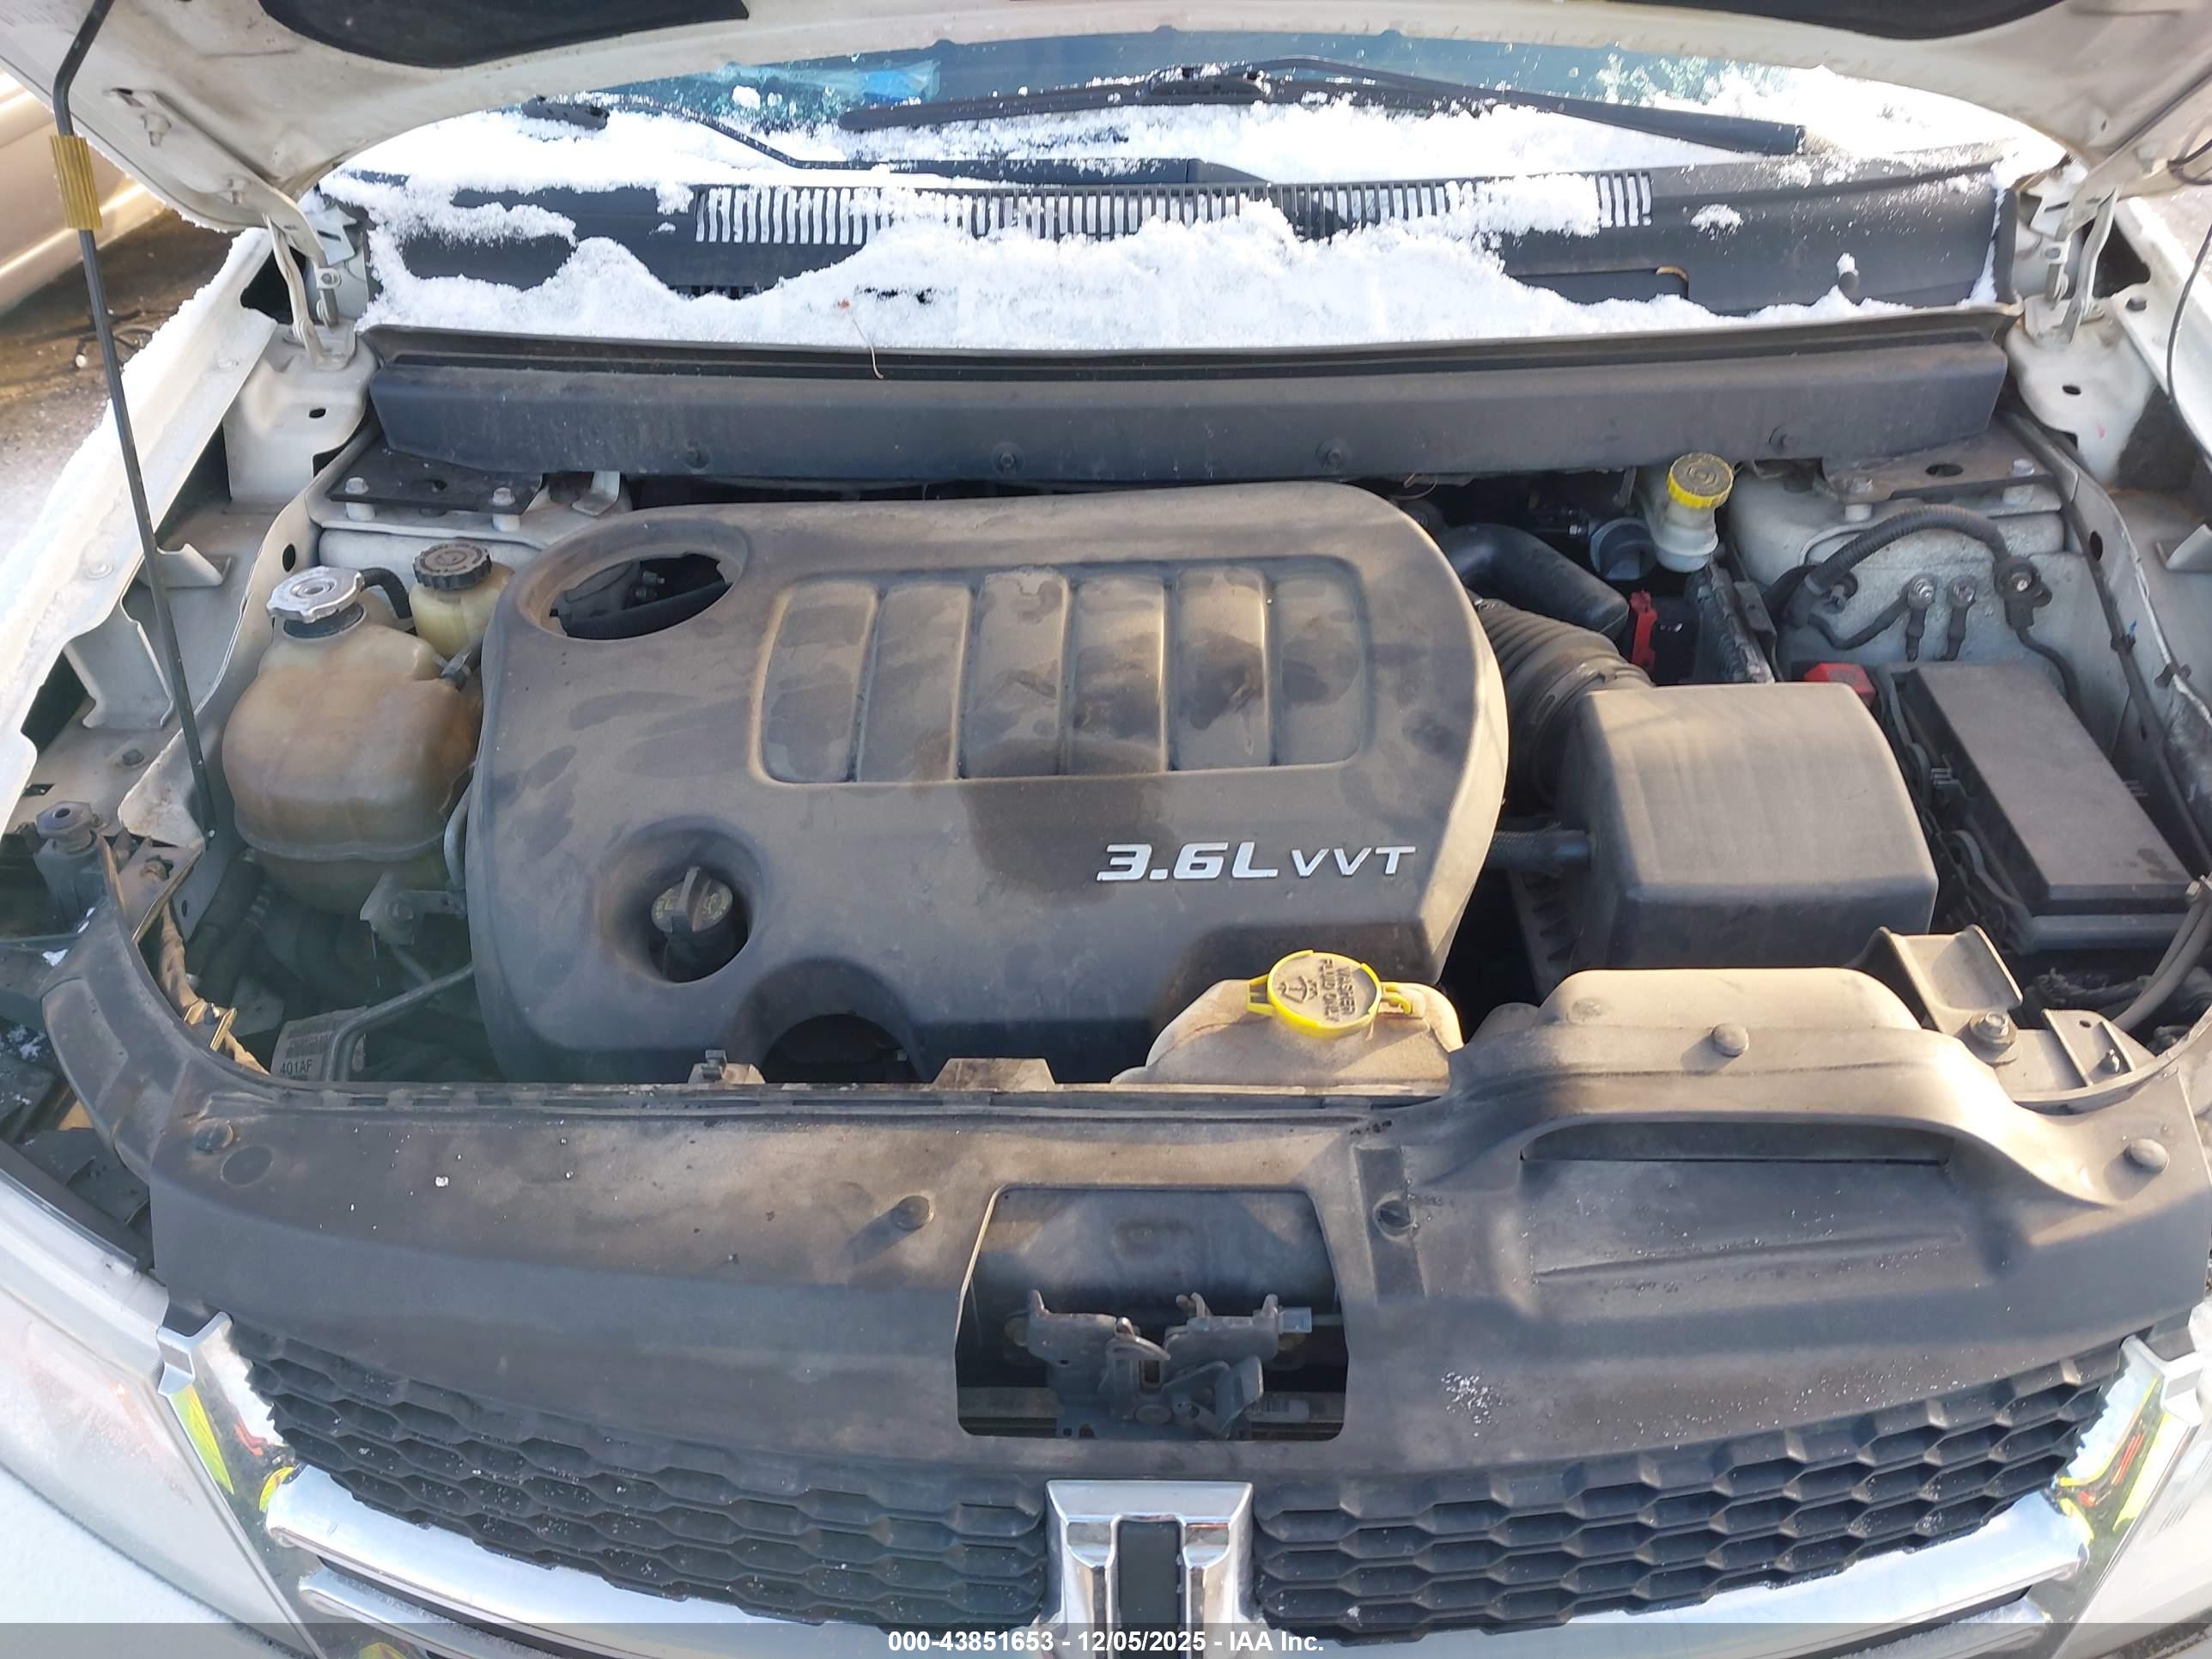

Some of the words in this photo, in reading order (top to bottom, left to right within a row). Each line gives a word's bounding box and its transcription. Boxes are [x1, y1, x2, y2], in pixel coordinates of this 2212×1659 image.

[1097, 842, 1278, 881] 3.6L
[1291, 846, 1416, 877] VVT
[1319, 958, 1336, 990] FLUID
[1337, 967, 1356, 1014] WASHER
[1323, 993, 1340, 1022] ONLY
[280, 1059, 313, 1075] 401AF
